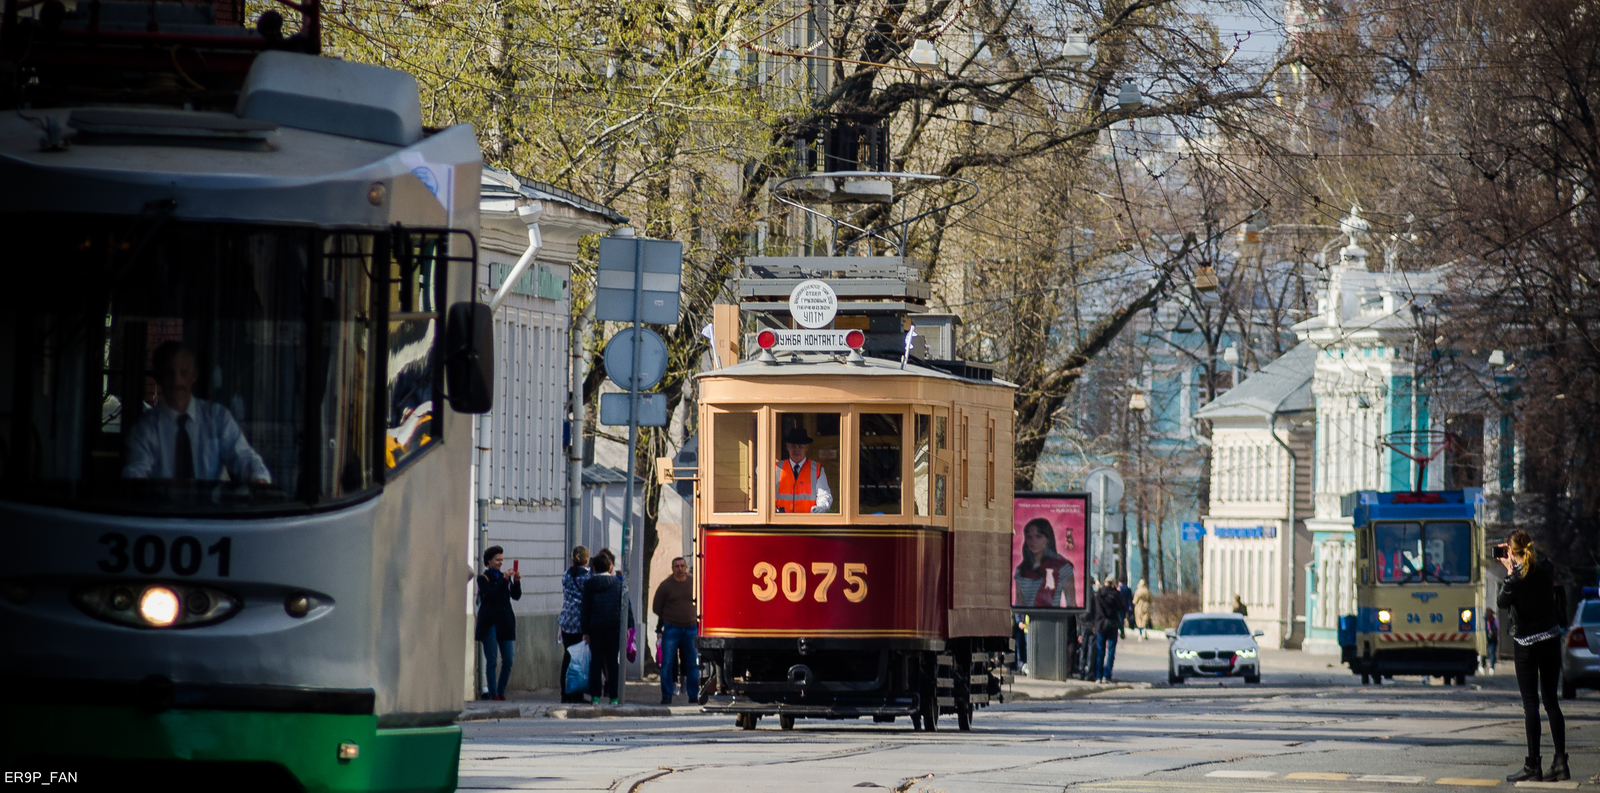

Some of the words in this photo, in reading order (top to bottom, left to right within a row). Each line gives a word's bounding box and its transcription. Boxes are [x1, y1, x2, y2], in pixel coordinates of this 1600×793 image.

[803, 311, 824, 323] УПТМ
[97, 532, 231, 577] 3001
[752, 561, 868, 603] 3075
